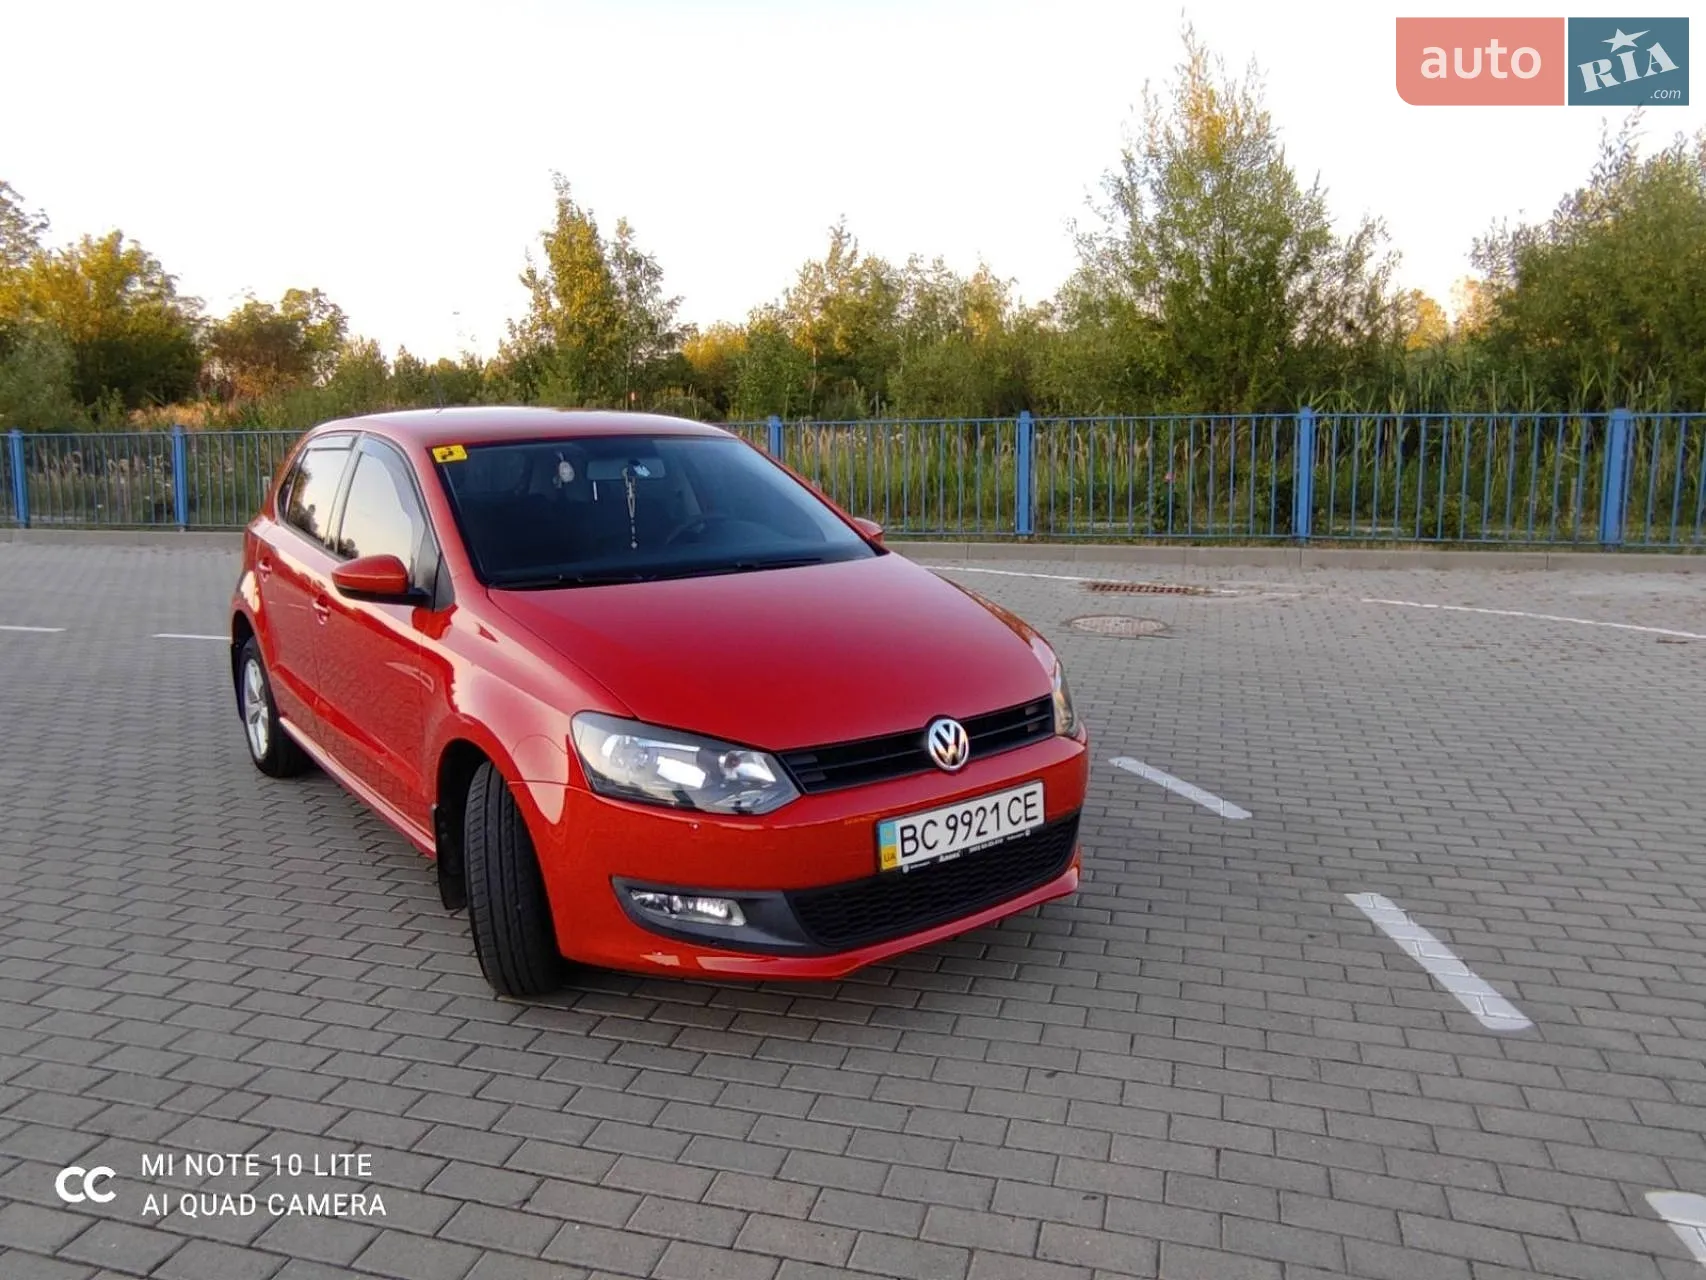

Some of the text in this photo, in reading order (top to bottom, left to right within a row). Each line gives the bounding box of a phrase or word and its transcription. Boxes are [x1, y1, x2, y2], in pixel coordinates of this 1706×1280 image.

[900, 820, 939, 857] BC
[945, 801, 1001, 845] 9921
[1007, 790, 1038, 825] CE
[883, 851, 896, 862] UA
